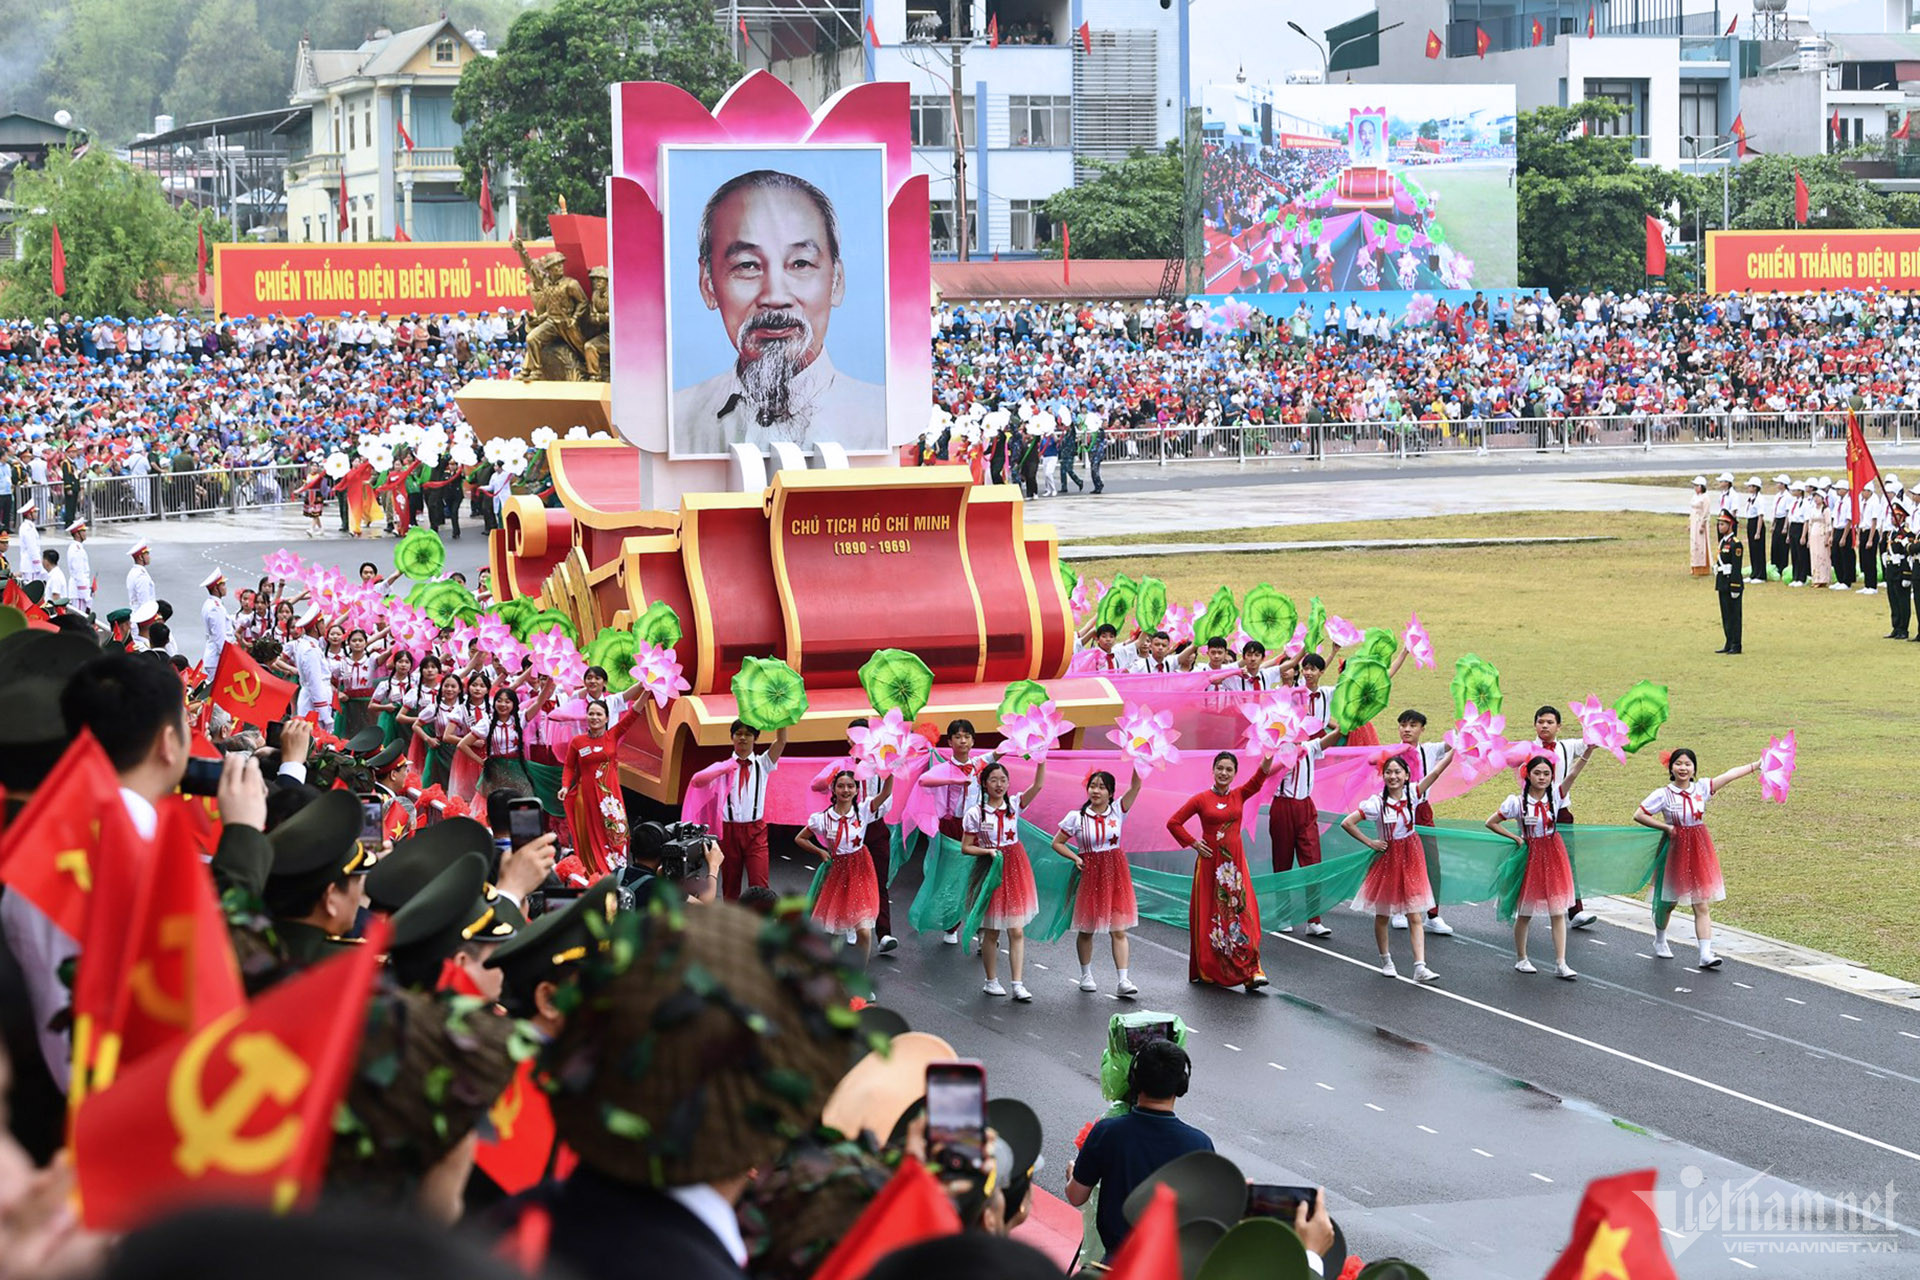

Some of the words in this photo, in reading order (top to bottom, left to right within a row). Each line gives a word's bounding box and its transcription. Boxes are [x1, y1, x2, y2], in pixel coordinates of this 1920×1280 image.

[1747, 244, 1796, 279] CHIẾN
[1800, 243, 1853, 278] THẮNG
[1857, 246, 1895, 284] ĐIỆN
[255, 260, 301, 301] CHIẾN
[304, 258, 354, 300] THẮNG
[358, 263, 395, 306] ĐIỆN
[399, 262, 436, 299] BIÊN
[440, 258, 471, 298] PHỦ
[486, 261, 527, 298] LỪNG
[791, 515, 820, 535] CHỦ
[826, 518, 857, 536] TỊCH
[862, 513, 881, 533] HỒ
[886, 513, 909, 532] CHÍ
[914, 515, 950, 531] MINH
[834, 541, 867, 555] (1890
[878, 539, 911, 553] 1969)
